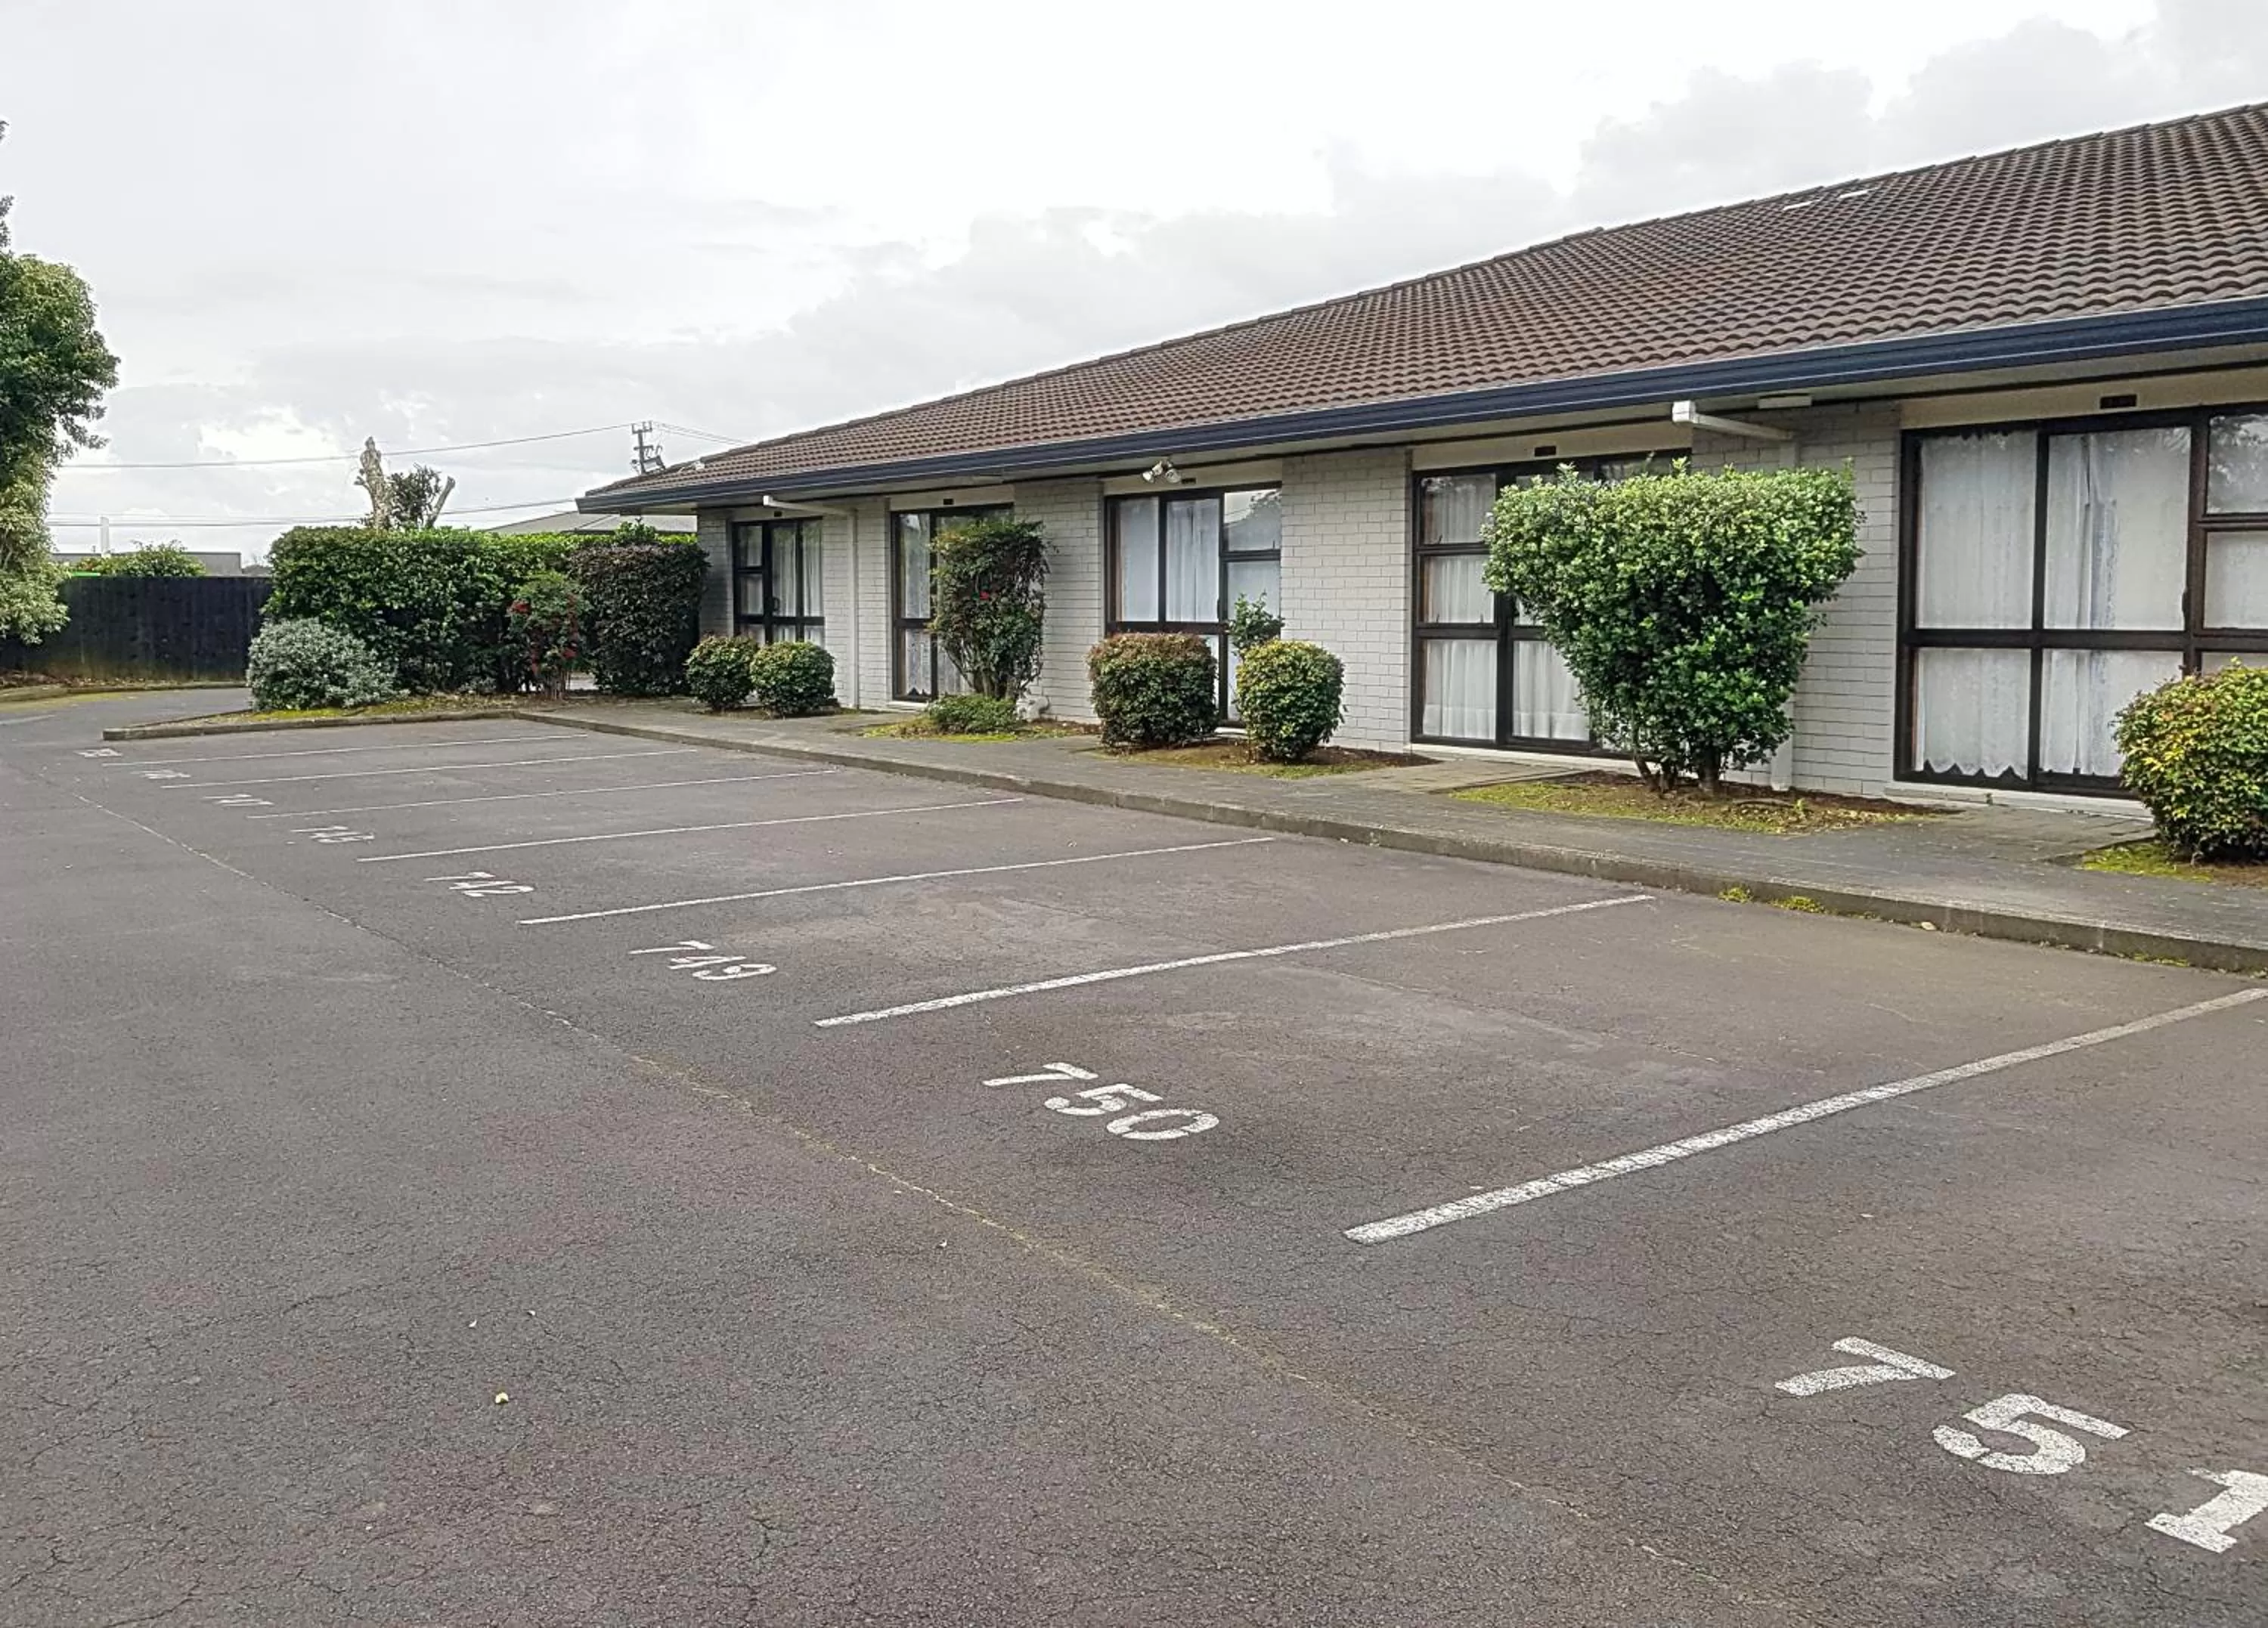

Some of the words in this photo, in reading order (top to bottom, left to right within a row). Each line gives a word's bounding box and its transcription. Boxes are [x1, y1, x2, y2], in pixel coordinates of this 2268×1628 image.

[628, 939, 777, 980] 749
[983, 1062, 1219, 1140] 750
[1775, 1336, 2268, 1553] 751
